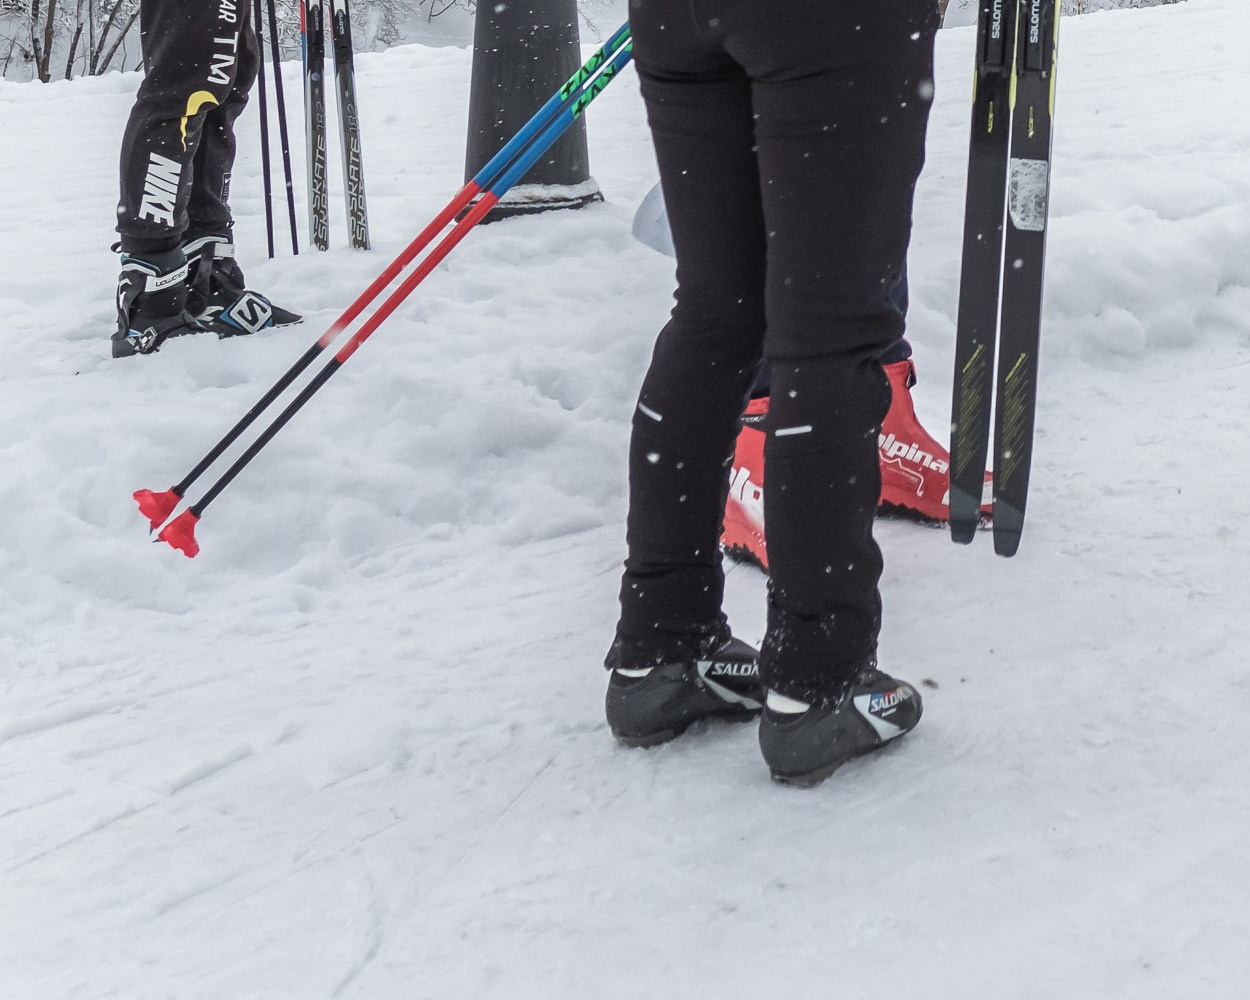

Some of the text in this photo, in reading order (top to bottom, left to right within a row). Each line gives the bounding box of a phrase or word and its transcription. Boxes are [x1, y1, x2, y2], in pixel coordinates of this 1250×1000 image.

[207, 31, 238, 85] TM
[138, 152, 182, 228] NIKE
[312, 134, 326, 210] SKATE
[348, 136, 361, 211] SKATE
